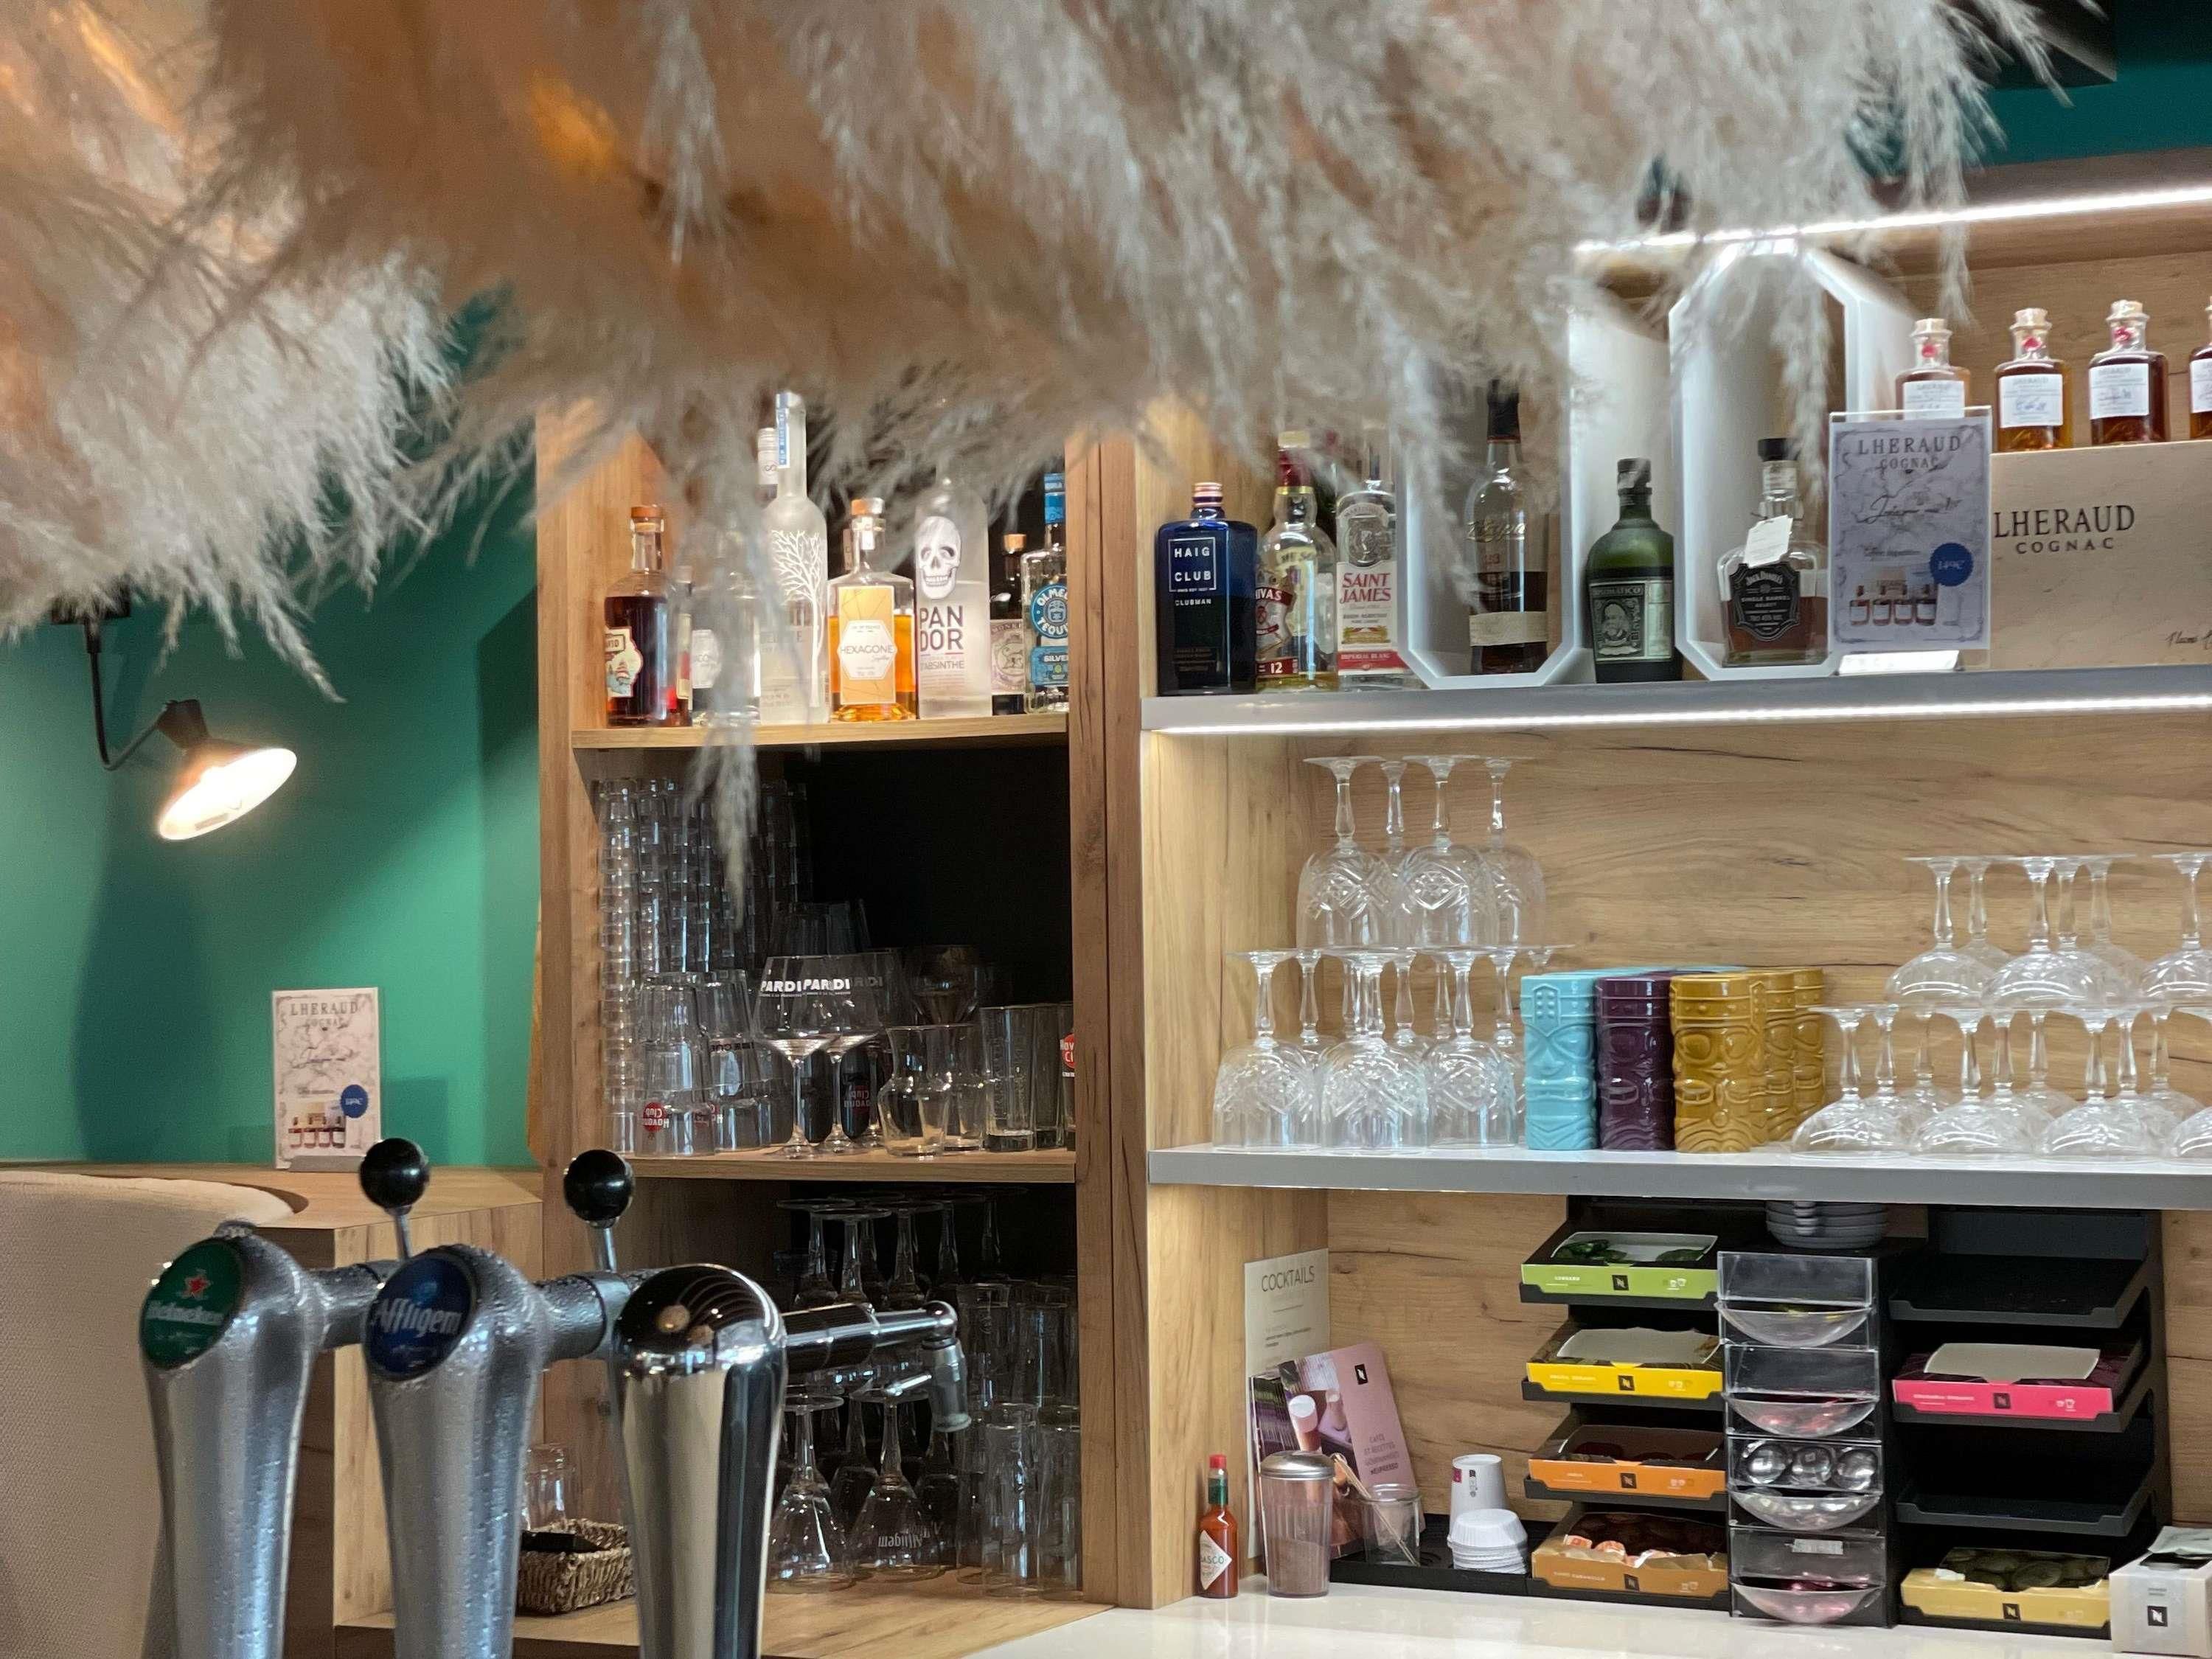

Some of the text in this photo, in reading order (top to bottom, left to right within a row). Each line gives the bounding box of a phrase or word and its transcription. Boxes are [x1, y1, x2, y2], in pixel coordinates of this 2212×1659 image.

[1857, 435, 1962, 455] LHERAUD
[1880, 456, 1941, 470] COGNAC
[1993, 504, 2135, 538] LHERAUD
[1174, 546, 1210, 558] HAIG
[2015, 536, 2115, 555] COGNAC
[1174, 570, 1211, 582] CLUB
[1342, 572, 1391, 588] SAINT
[1175, 598, 1212, 606] CLUBMAN
[1339, 588, 1392, 605] JAMES
[919, 605, 964, 628] PAN
[919, 628, 964, 652] DOR
[840, 644, 894, 655] HEXAGONE
[1043, 654, 1068, 662] SILVE
[1270, 661, 1284, 674] 12
[760, 978, 850, 992] PARDI PARDI
[290, 1001, 358, 1016] LHERAUD
[1262, 1265, 1315, 1293] COCKTAILS
[374, 1297, 463, 1339] Affligem
[1200, 1555, 1225, 1565] ASCO
